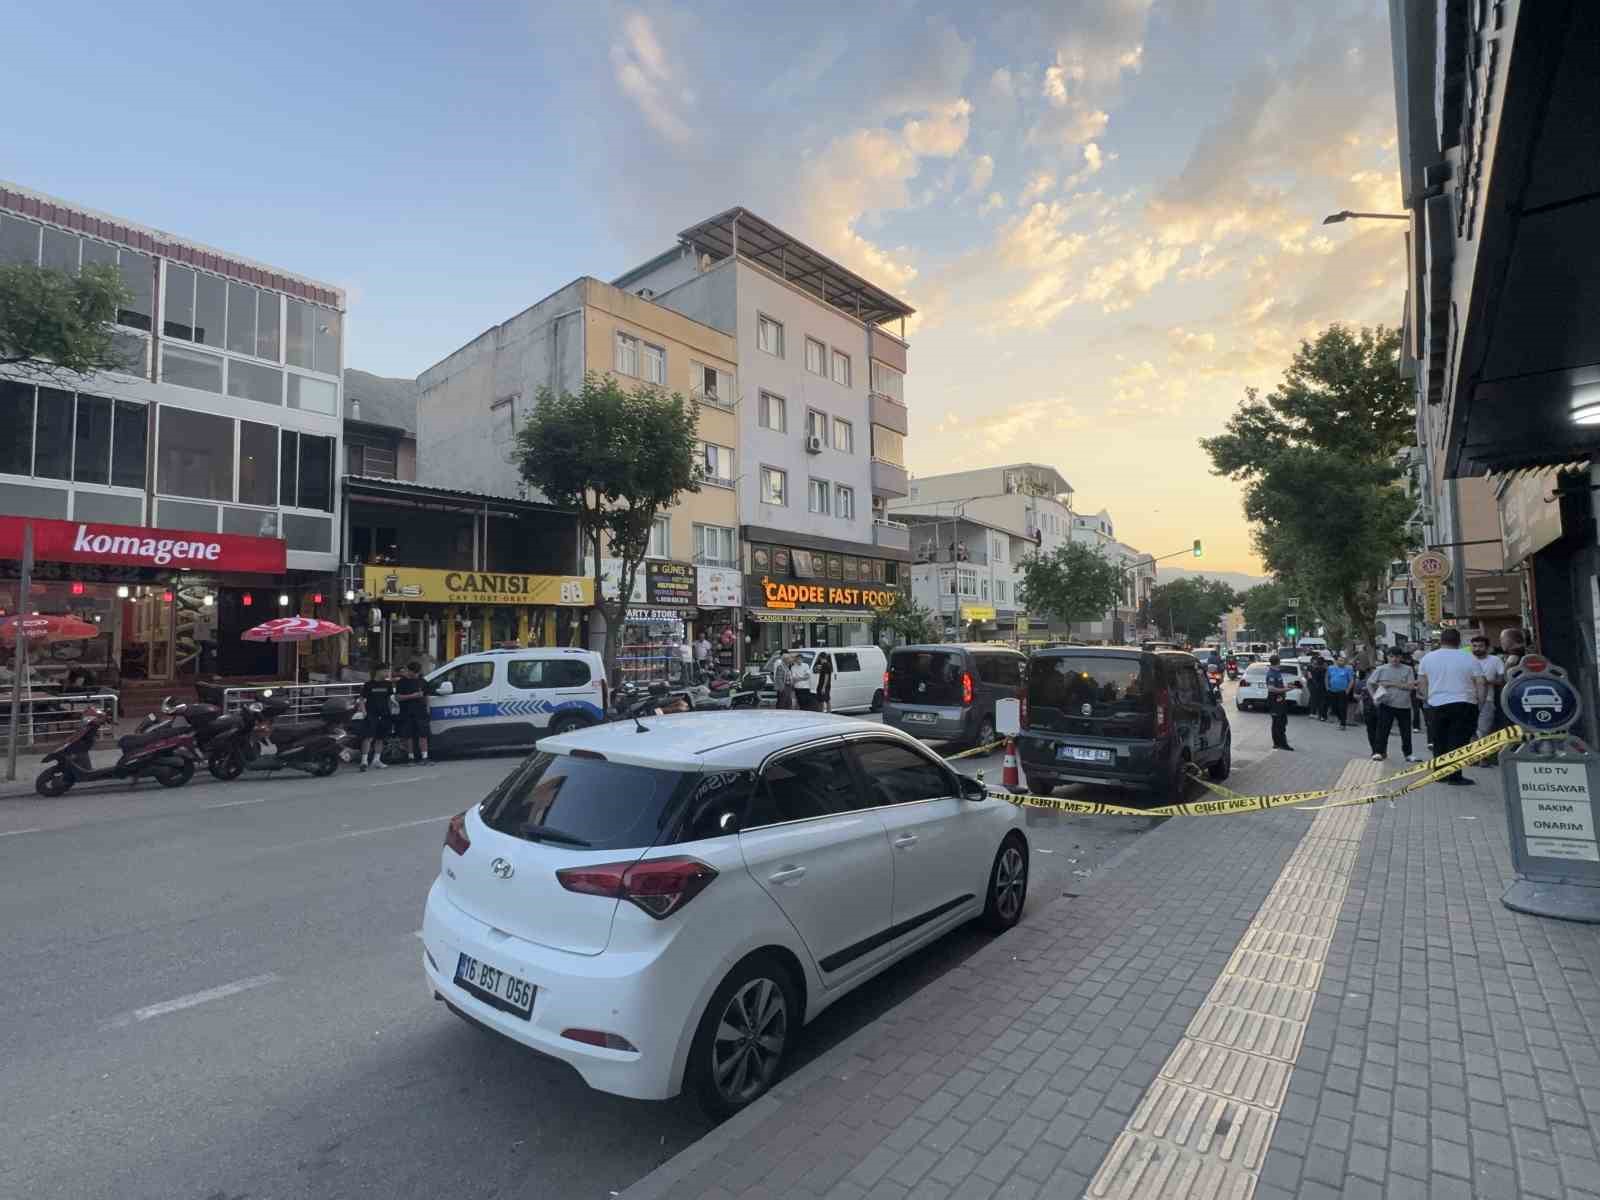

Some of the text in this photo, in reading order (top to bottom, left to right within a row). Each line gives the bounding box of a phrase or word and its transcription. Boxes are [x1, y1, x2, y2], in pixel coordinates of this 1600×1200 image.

[74, 524, 221, 565] komagene
[445, 573, 529, 594] CANISI
[766, 583, 896, 607] CADDEE FAST FOOD
[625, 609, 678, 618] ARTY STORE
[1521, 781, 1587, 793] BİLGİSAYAR
[1538, 803, 1574, 812] BAKIM
[1534, 821, 1584, 831] ONARIM
[465, 957, 531, 1007] 16 BST 056
